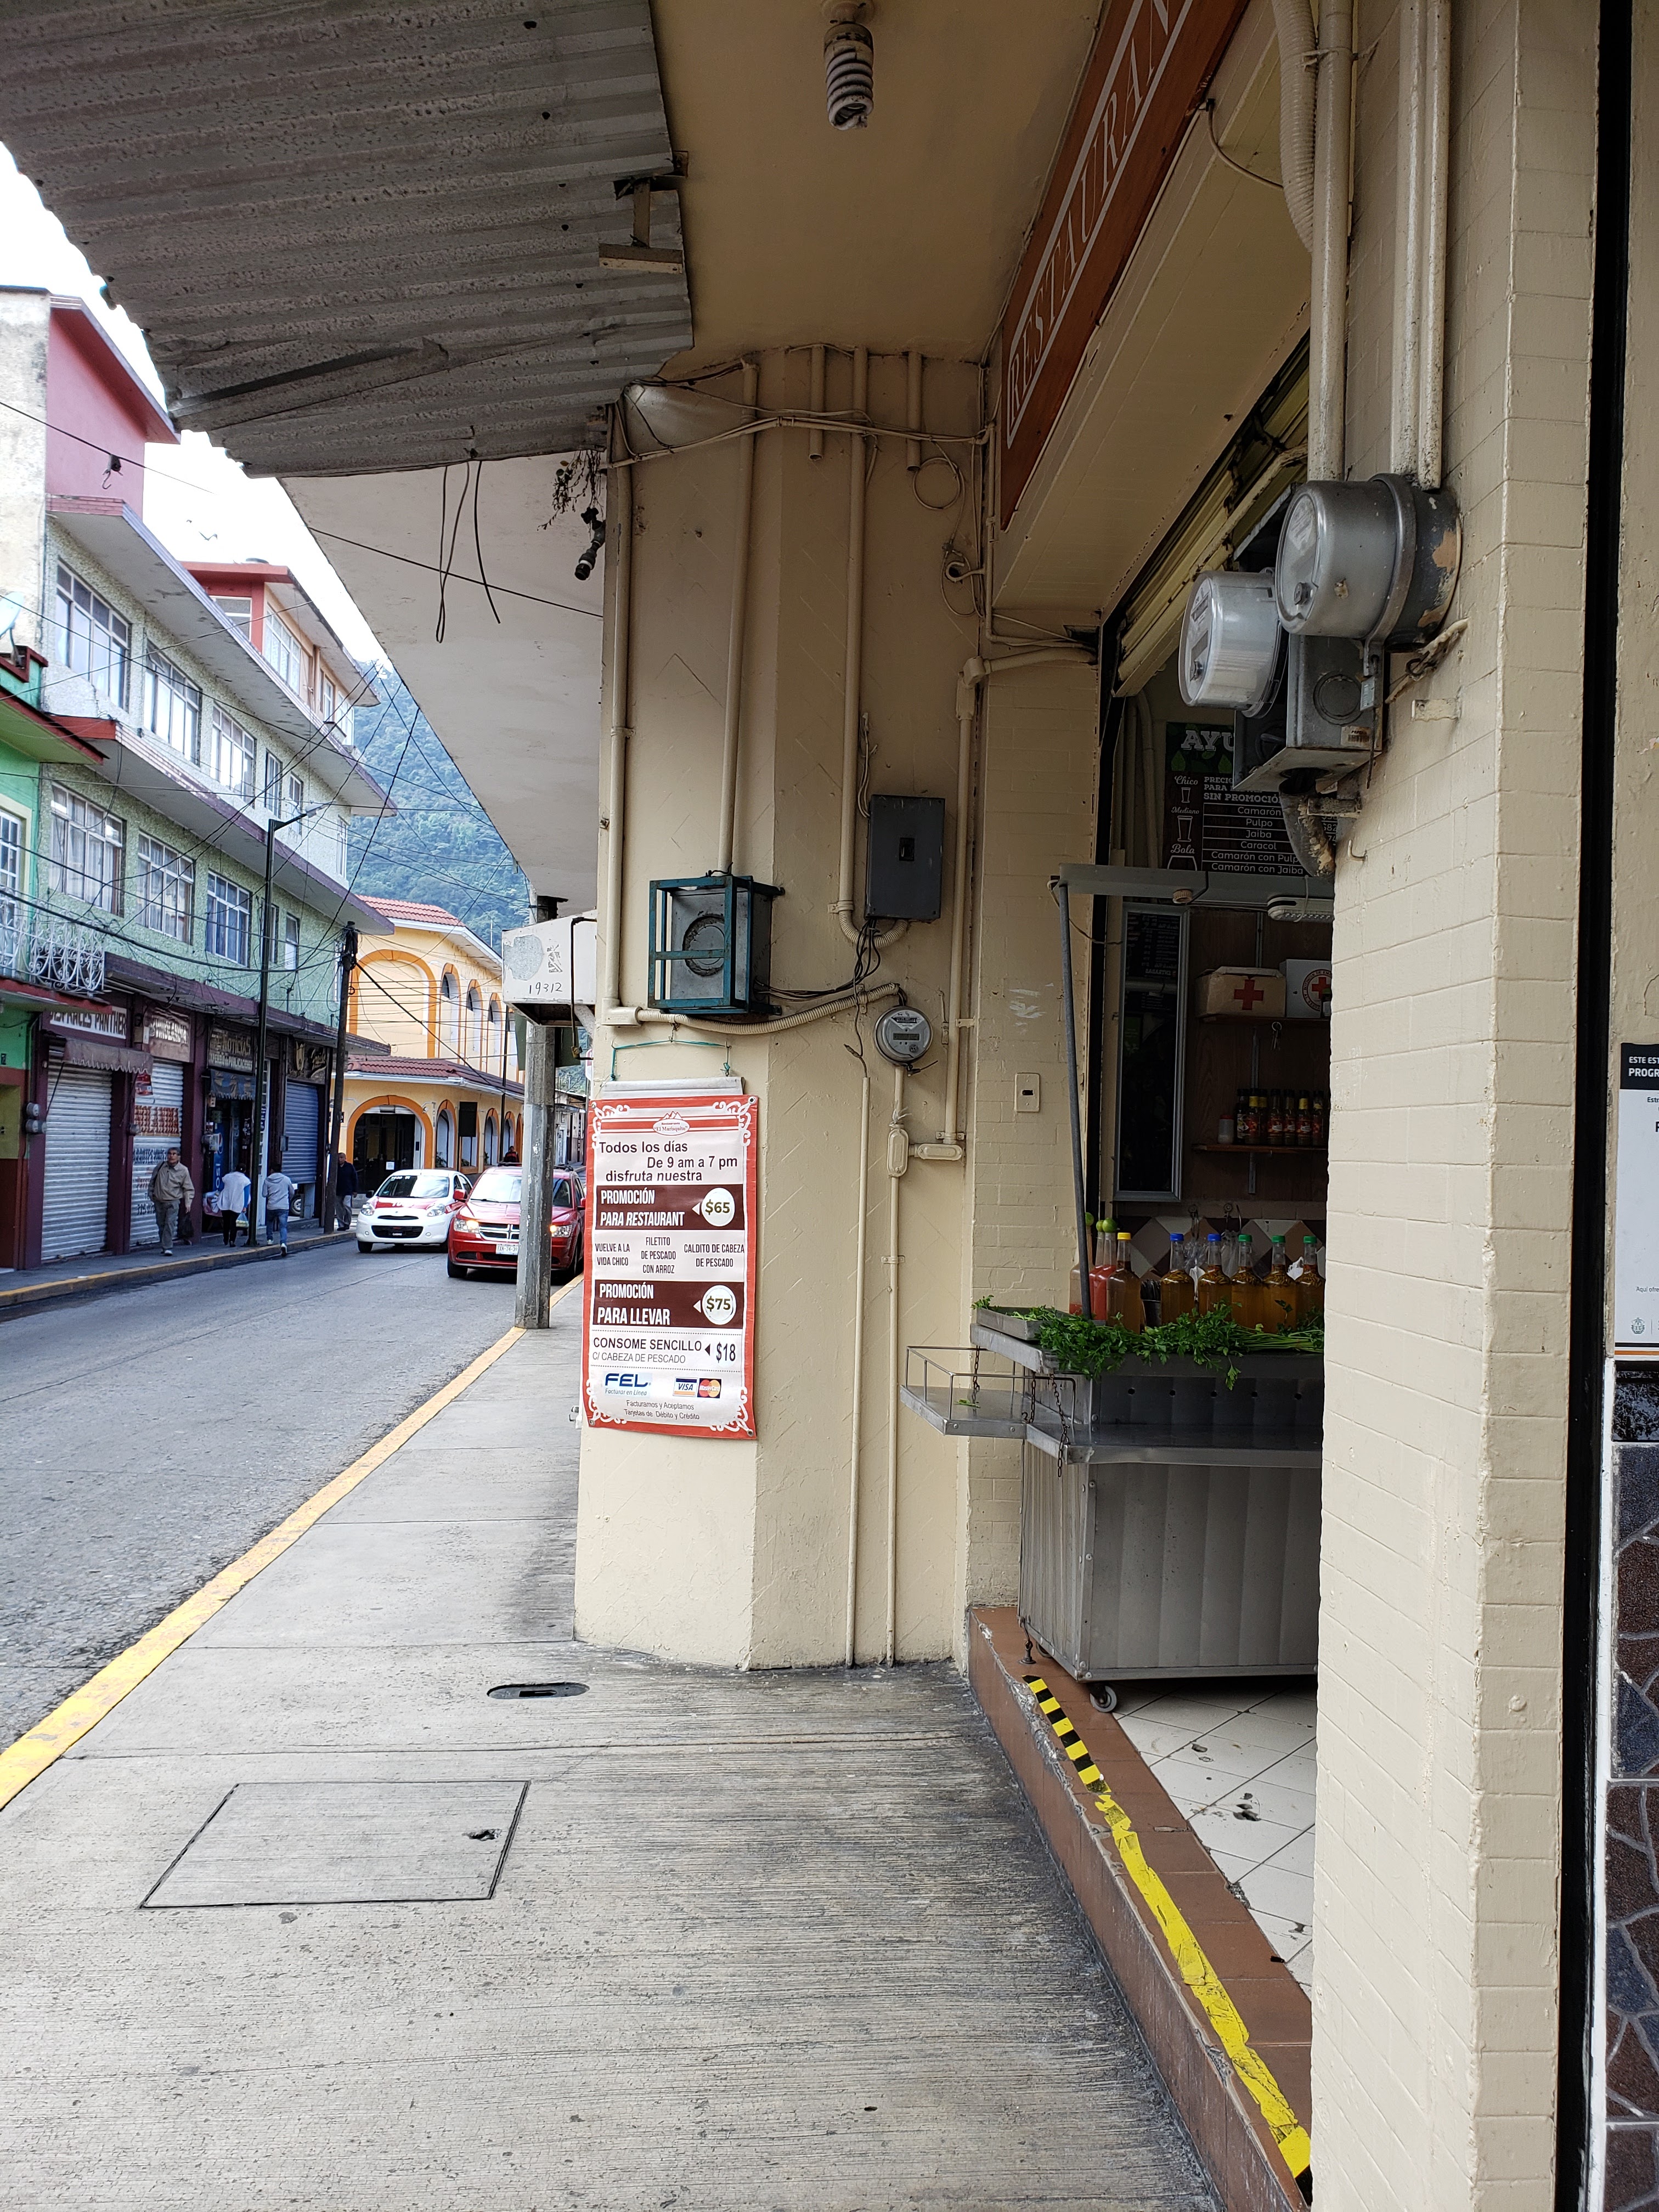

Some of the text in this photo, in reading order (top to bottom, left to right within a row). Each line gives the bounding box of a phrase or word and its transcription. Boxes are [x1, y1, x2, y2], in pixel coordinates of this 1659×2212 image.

[1175, 775, 1198, 785] Chico
[1224, 794, 1281, 803] PROMOCIÓ
[1238, 806, 1281, 816] Camarón
[1246, 818, 1273, 828] Pulpo
[1245, 830, 1272, 838] Jaiba
[1171, 844, 1195, 854] Bola
[1240, 841, 1277, 850] Caracol
[1211, 851, 1255, 861] Camarón
[1278, 854, 1299, 864] Pulp
[1211, 863, 1255, 872] Camarón
[1278, 866, 1303, 874] Jaiba
[529, 982, 562, 995] 19312
[1628, 1068, 1659, 1077] PROGR
[599, 1140, 687, 1153] Todos los días
[647, 1156, 737, 1170] De 9 am a 7 pm
[606, 1170, 702, 1181] disfruta nuestra
[601, 1187, 655, 1204] PROMOCIÓN
[705, 1199, 730, 1215] $65
[600, 1211, 685, 1226] PARA RESTAURANT
[646, 1237, 670, 1246] FILETITO
[595, 1244, 630, 1252] VUELVE A LA
[684, 1244, 744, 1253] CALDITO DE CABEZA
[641, 1251, 676, 1260] DE PESCADO
[597, 1257, 628, 1266] VIDA CHICO
[696, 1258, 733, 1267] DE PESCADO
[642, 1265, 674, 1274] CON ARROZ
[600, 1282, 654, 1299] PROMOCIÓN
[706, 1296, 731, 1312] $75
[597, 1307, 670, 1325] PARA LLEVAR
[594, 1338, 736, 1363] CONSOME SENCILLO $18
[601, 1352, 634, 1362] CABEZA
[635, 1353, 646, 1362] DE
[647, 1354, 686, 1363] PESCADO
[605, 1373, 648, 1387] FEL
[627, 1400, 658, 1409] Facturamos
[624, 1409, 645, 1417] Tarjetas
[679, 1412, 699, 1420] Crédito
